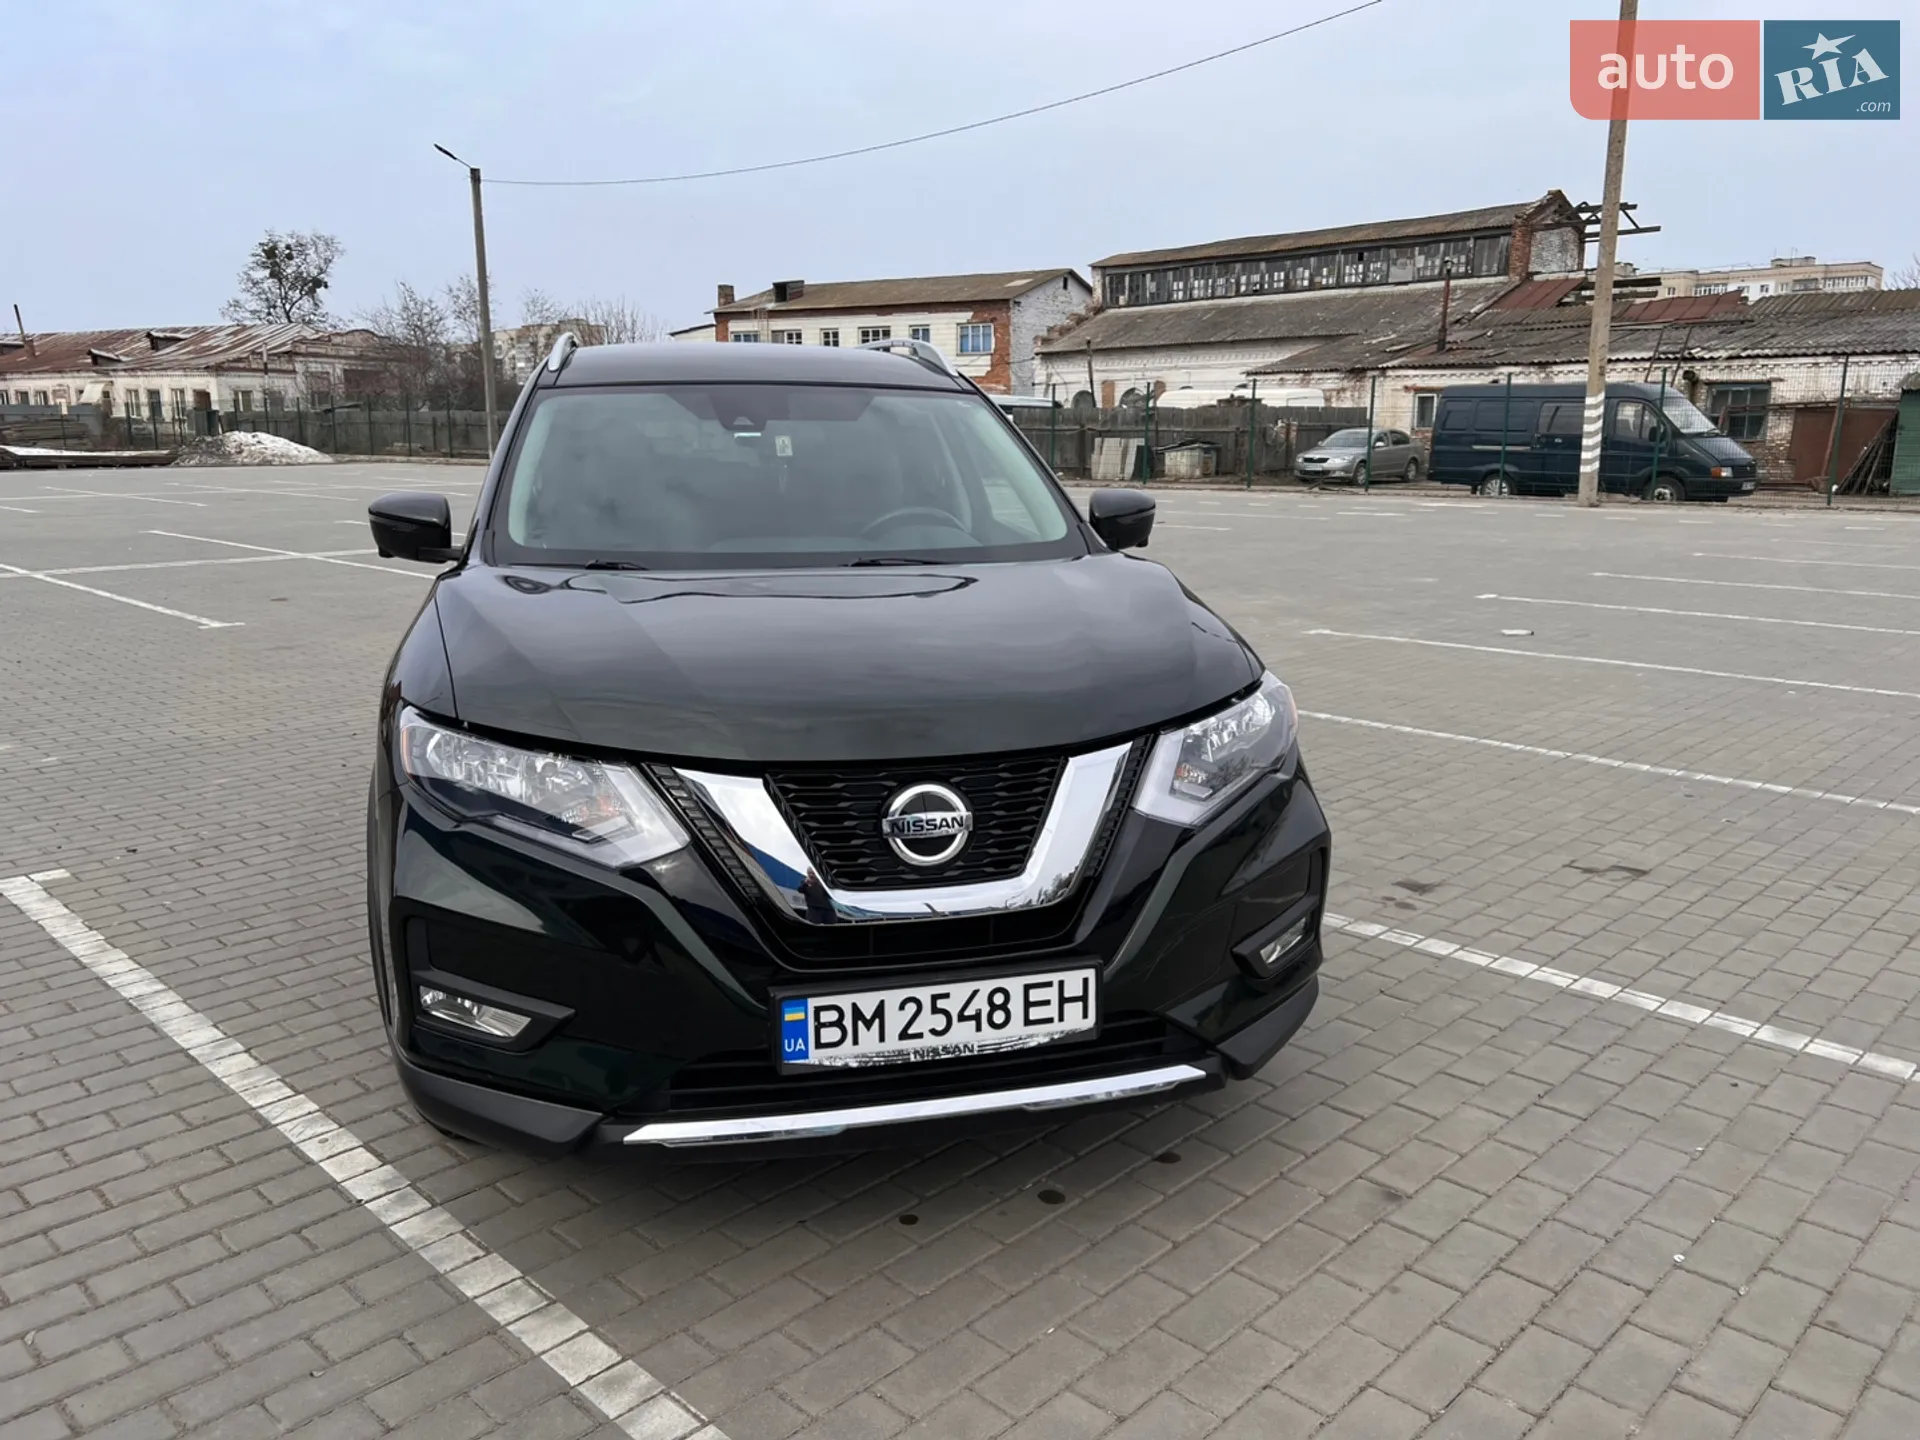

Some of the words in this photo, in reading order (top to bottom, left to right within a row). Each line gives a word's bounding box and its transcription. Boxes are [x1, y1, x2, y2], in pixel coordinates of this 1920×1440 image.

[891, 816, 964, 834] NISSAN
[813, 999, 886, 1050] BM
[897, 986, 1012, 1041] 2548
[1022, 976, 1090, 1027] EH
[784, 1037, 806, 1053] UA
[912, 1043, 975, 1060] NISSAN
